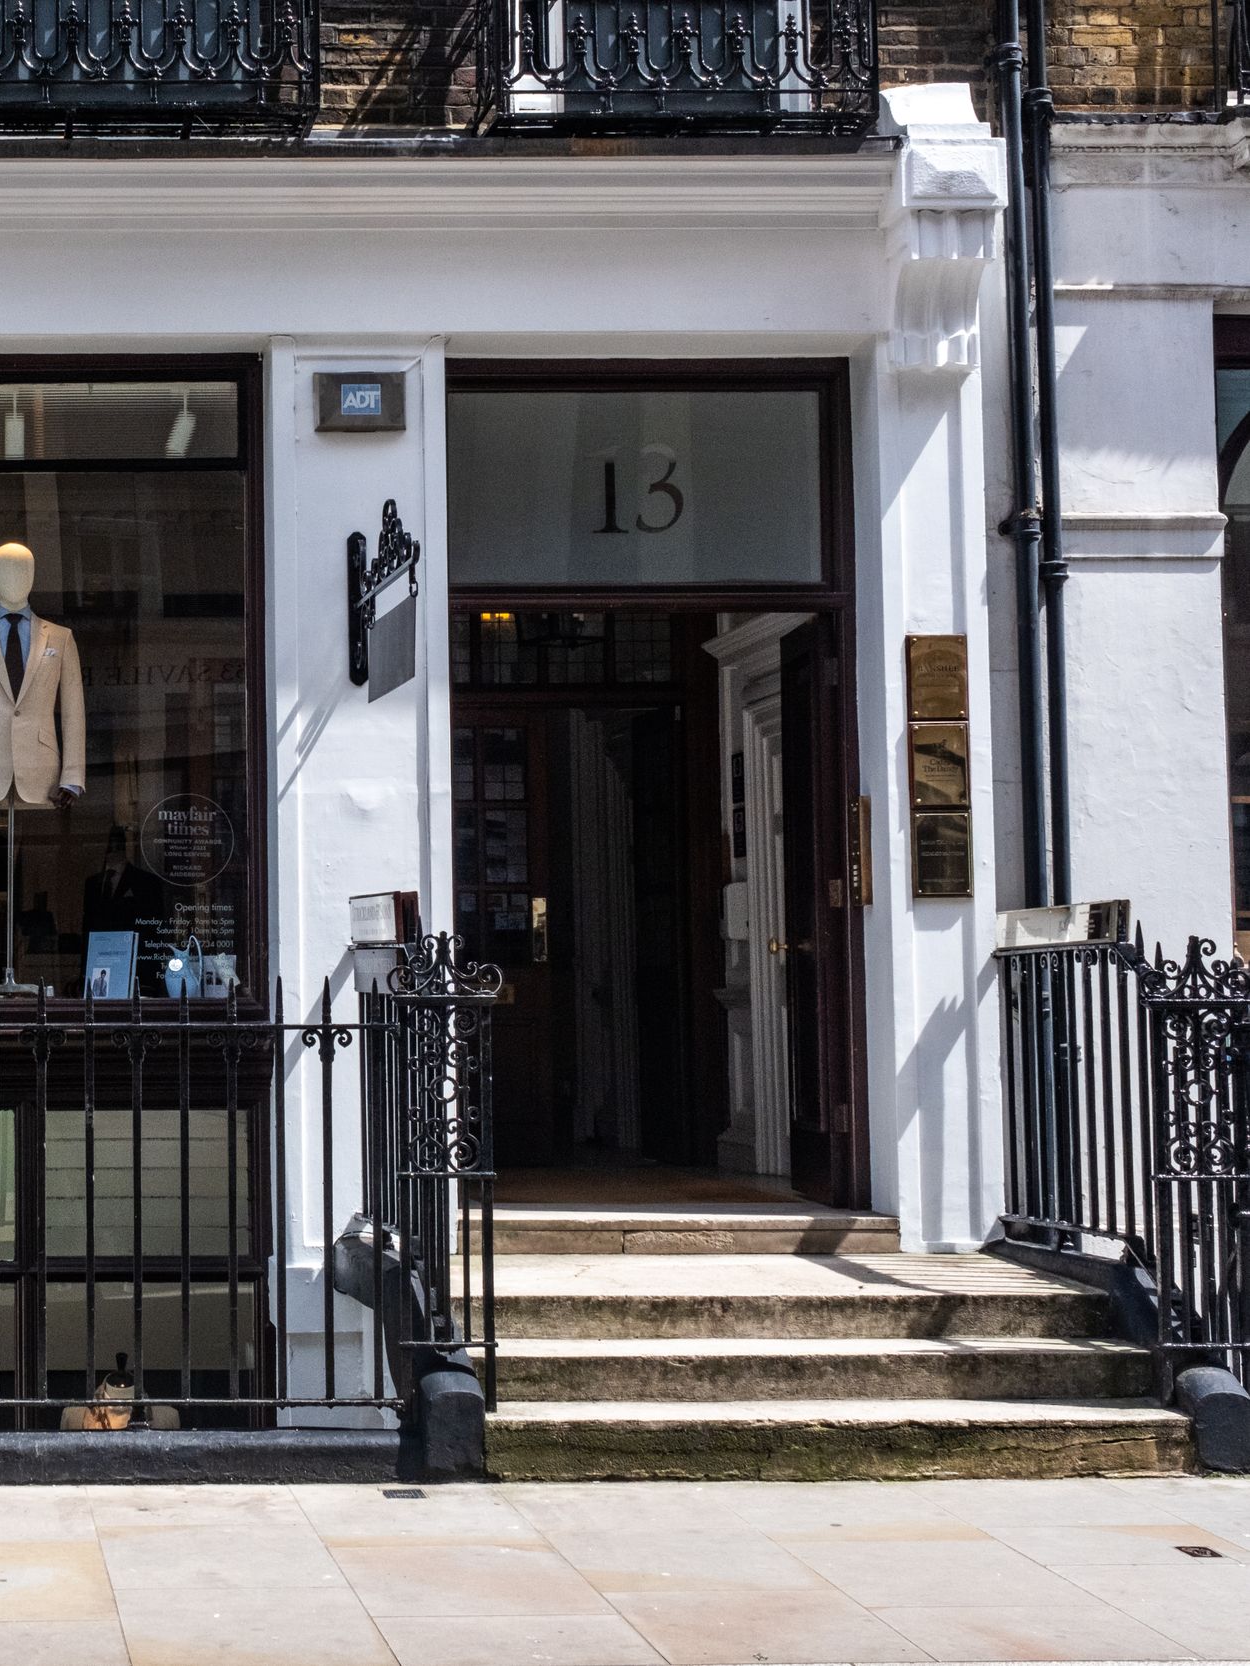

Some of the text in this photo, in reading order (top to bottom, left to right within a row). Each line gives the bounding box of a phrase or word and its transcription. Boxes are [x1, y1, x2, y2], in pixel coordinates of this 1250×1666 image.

[342, 390, 380, 409] ADT
[592, 443, 685, 534] 13
[158, 805, 217, 824] mayfair
[168, 821, 210, 836] times
[175, 903, 234, 914] Opening times:
[135, 917, 163, 927] Monday
[220, 917, 235, 927] 5pm
[220, 927, 235, 936] 5pm
